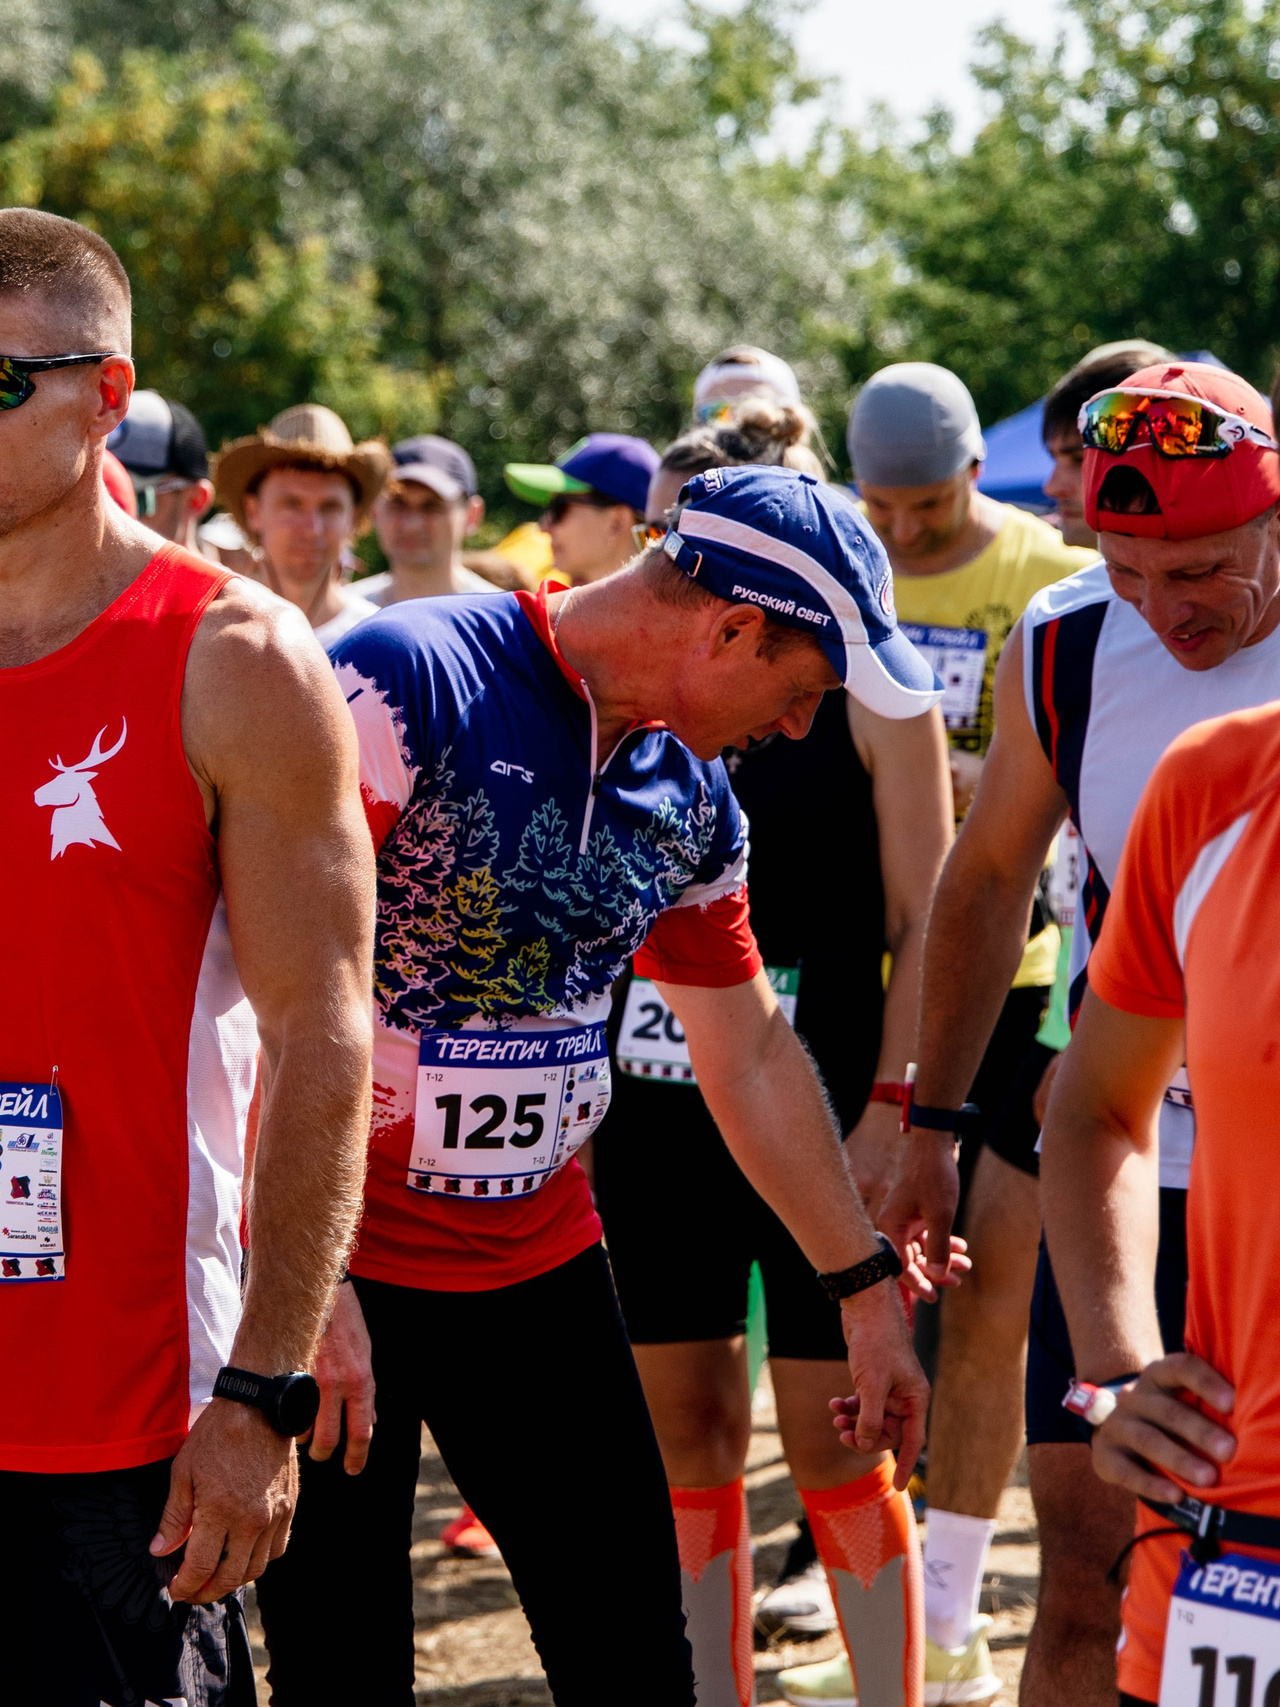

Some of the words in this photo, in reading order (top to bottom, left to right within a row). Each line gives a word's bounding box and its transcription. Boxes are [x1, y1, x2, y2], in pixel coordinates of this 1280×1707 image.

[732, 585, 796, 617] РУССКИЙ
[796, 606, 832, 627] СВЕТ
[436, 1037, 549, 1060] ТЕРЕНТИЧ
[556, 1028, 601, 1057] ТРЕЙЛ
[435, 1093, 546, 1149] 125
